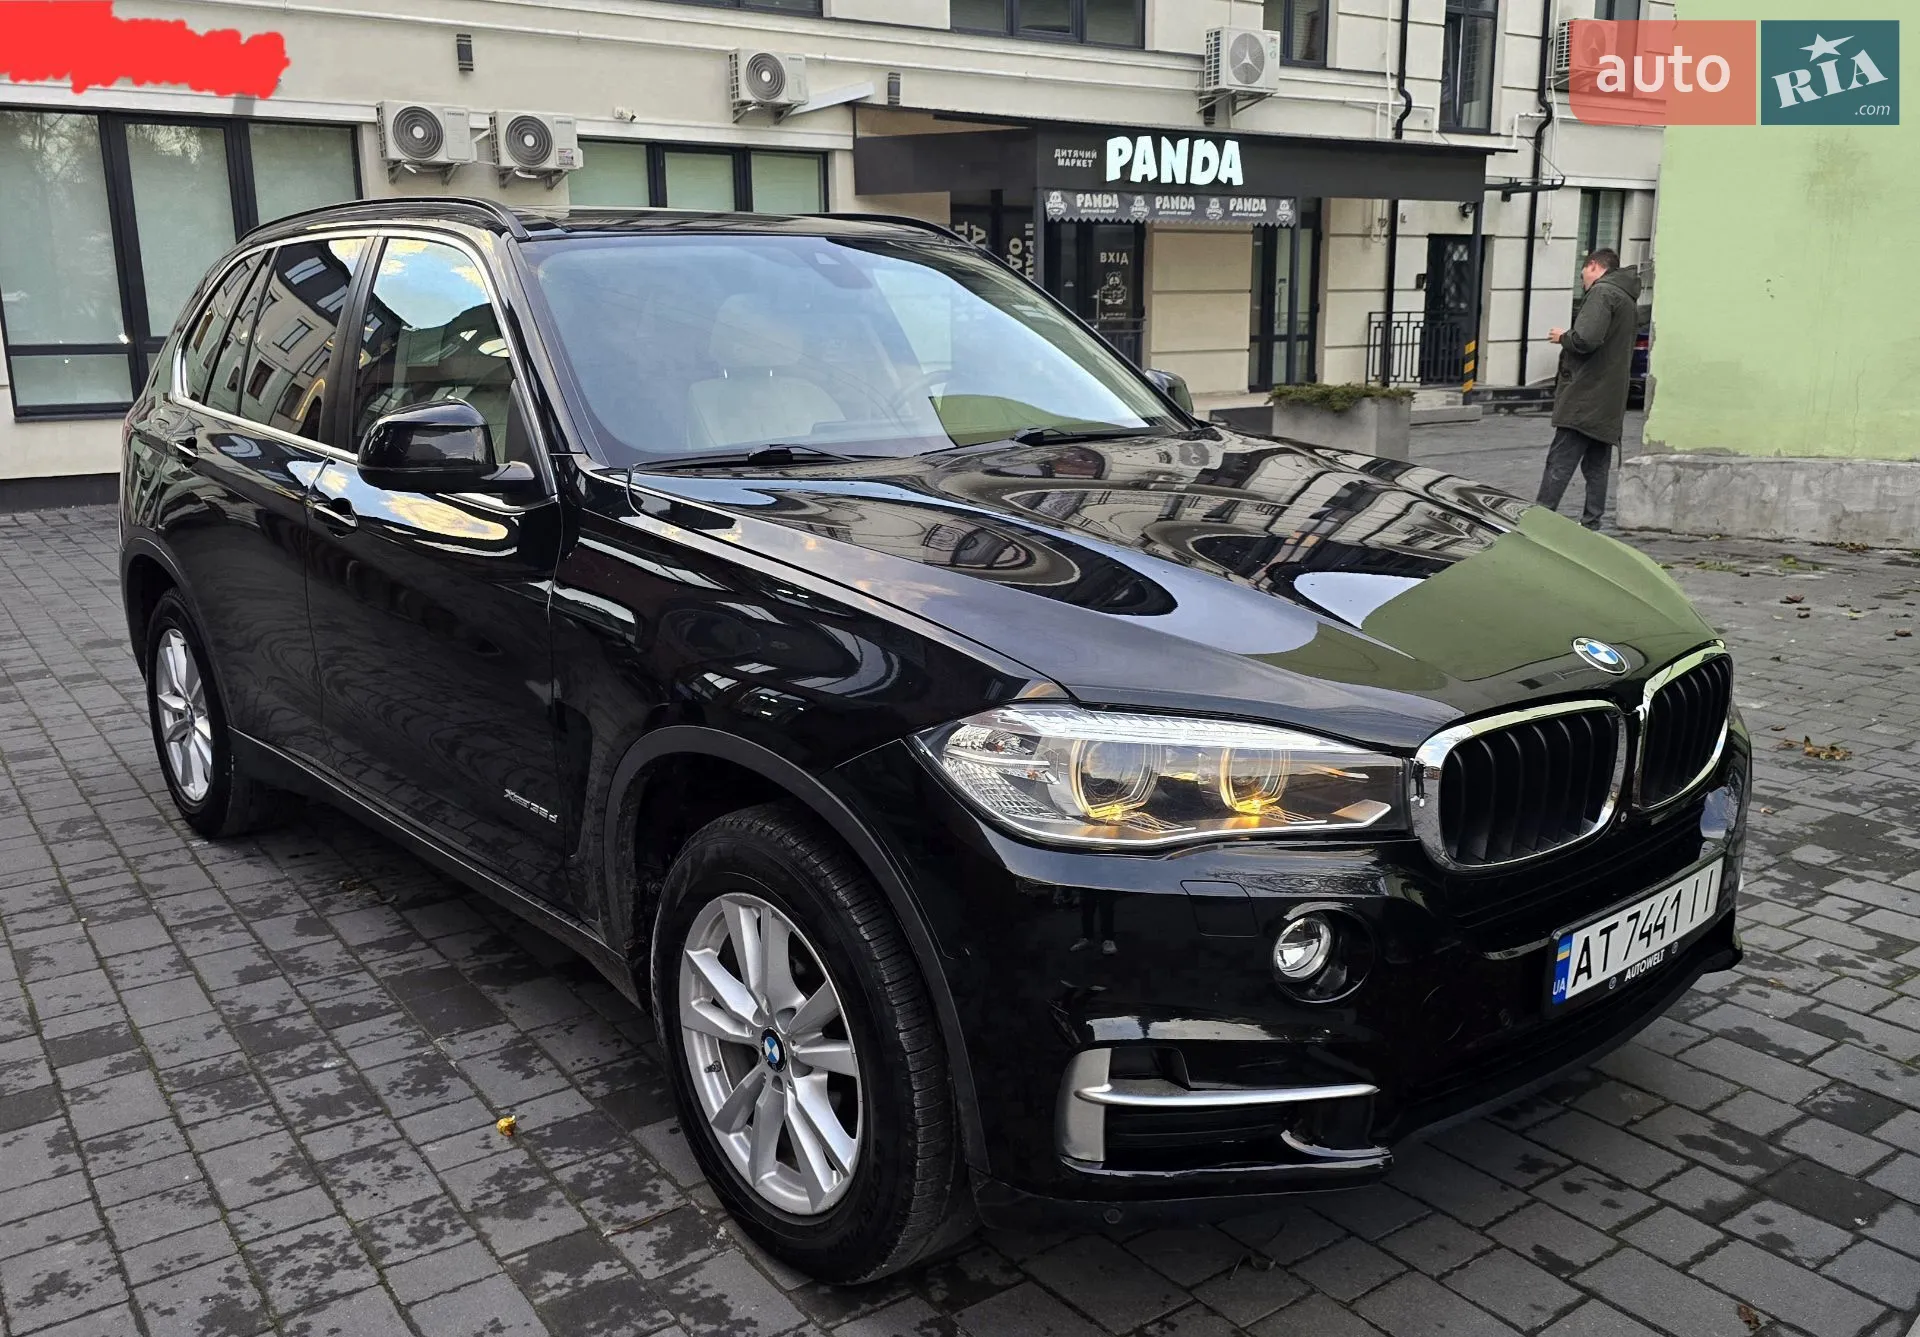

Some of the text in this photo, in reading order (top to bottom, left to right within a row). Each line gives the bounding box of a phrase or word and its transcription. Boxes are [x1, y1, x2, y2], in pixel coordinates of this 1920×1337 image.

[1054, 148, 1097, 159] ДИТЯЧИЙ
[1105, 136, 1244, 186] PANDA
[1057, 157, 1093, 168] МАРКЕТ
[1076, 193, 1119, 208] PANDA
[1155, 195, 1195, 210] PANDA
[1229, 197, 1267, 212] PANDA
[1100, 252, 1129, 265] ВХІД
[1571, 869, 1714, 988] AT 7441 II
[1624, 949, 1666, 982] AUTOWELT
[1552, 981, 1567, 996] UA
